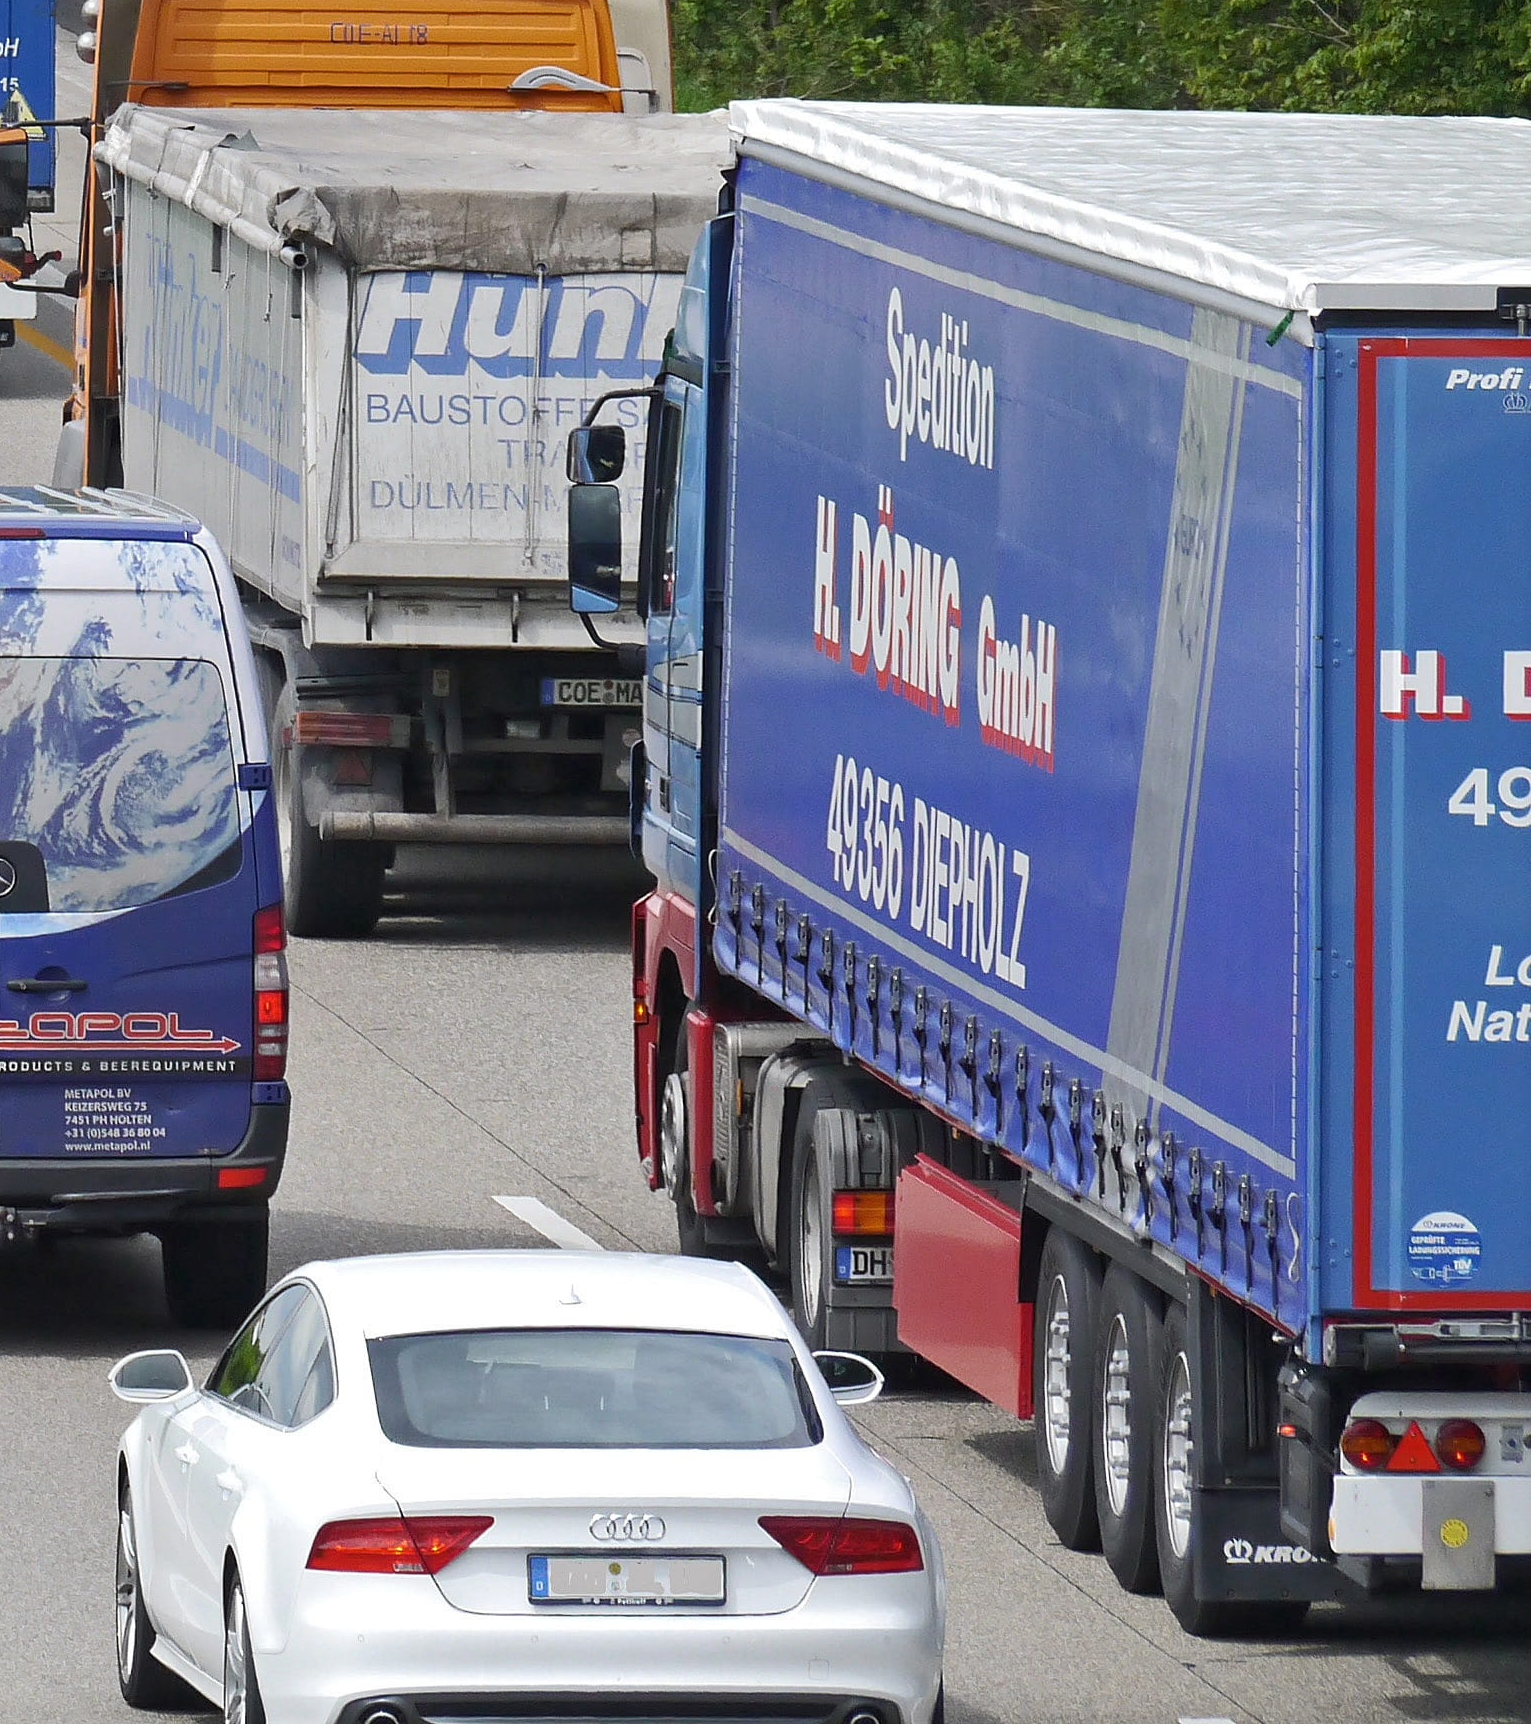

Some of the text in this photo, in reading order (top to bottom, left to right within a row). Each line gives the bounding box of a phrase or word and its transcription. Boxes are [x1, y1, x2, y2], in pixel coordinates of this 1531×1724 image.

[0, 77, 19, 92] 15
[884, 285, 995, 470] Spedition
[1445, 368, 1524, 391] Profi
[849, 485, 962, 728] DÖRING
[975, 595, 1058, 773] GmbH
[1380, 649, 1471, 722] H.
[826, 752, 1033, 990] 49356 DIEPHOLZ
[81, 1061, 91, 1072] &
[100, 1060, 237, 1073] BEEREQUIPMENT
[64, 1088, 132, 1099] METAPOL BV
[64, 1102, 147, 1113] KEIZERSWEG 75
[65, 1115, 152, 1125] 7451 PH HOLTEN
[152, 1127, 166, 1138] 04
[64, 1140, 150, 1154] www.metapol.nl
[852, 1250, 887, 1276] DH
[1254, 1546, 1323, 1564] KRO
